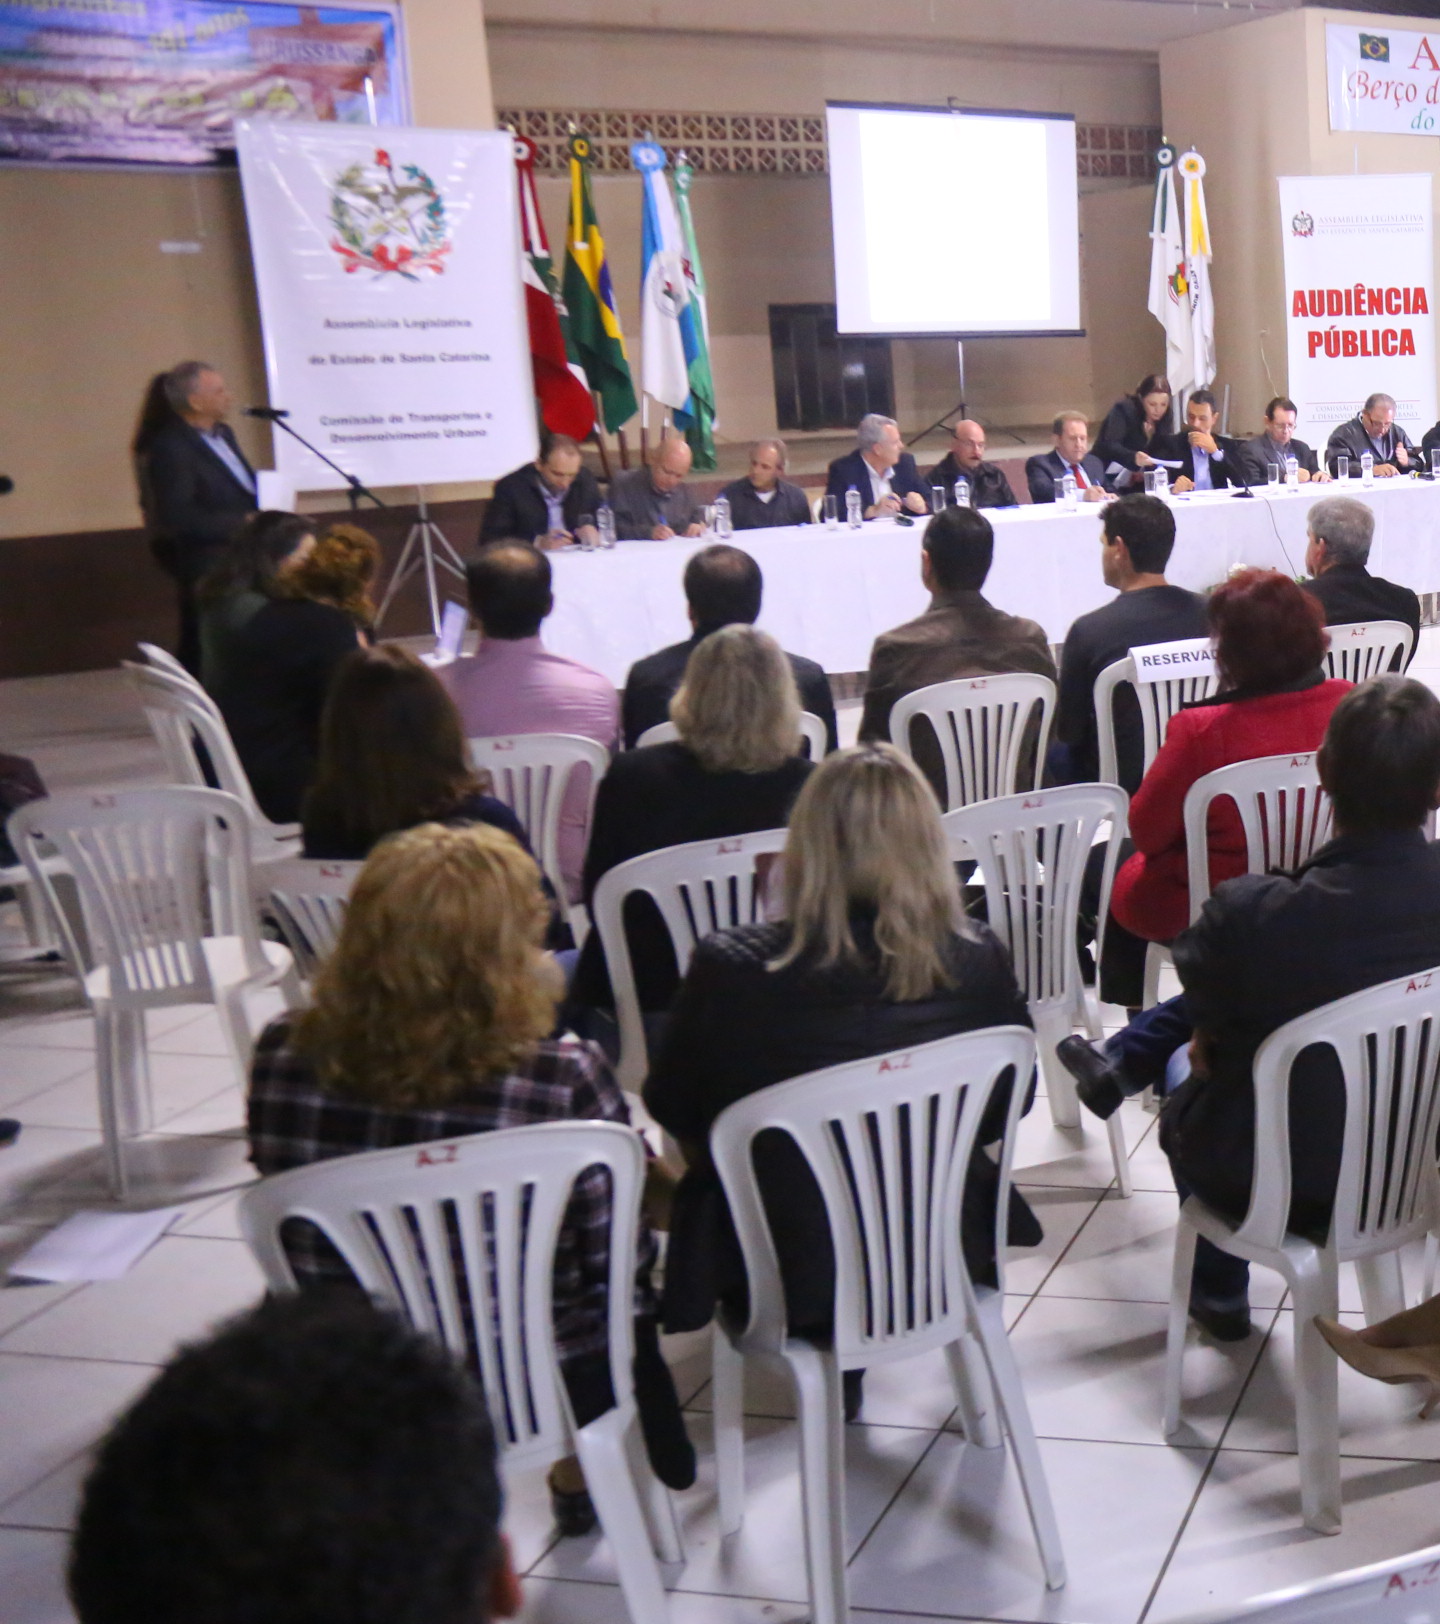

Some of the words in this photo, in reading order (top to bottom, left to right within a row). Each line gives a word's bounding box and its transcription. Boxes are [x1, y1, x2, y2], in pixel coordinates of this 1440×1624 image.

[1347, 70, 1417, 109] Berço
[1411, 108, 1435, 130] do
[1292, 283, 1429, 317] AUDIÊNCIA
[1307, 325, 1416, 358] PÚBLICA
[1142, 649, 1217, 666] RESERVAD
[1406, 973, 1433, 994] A.Z
